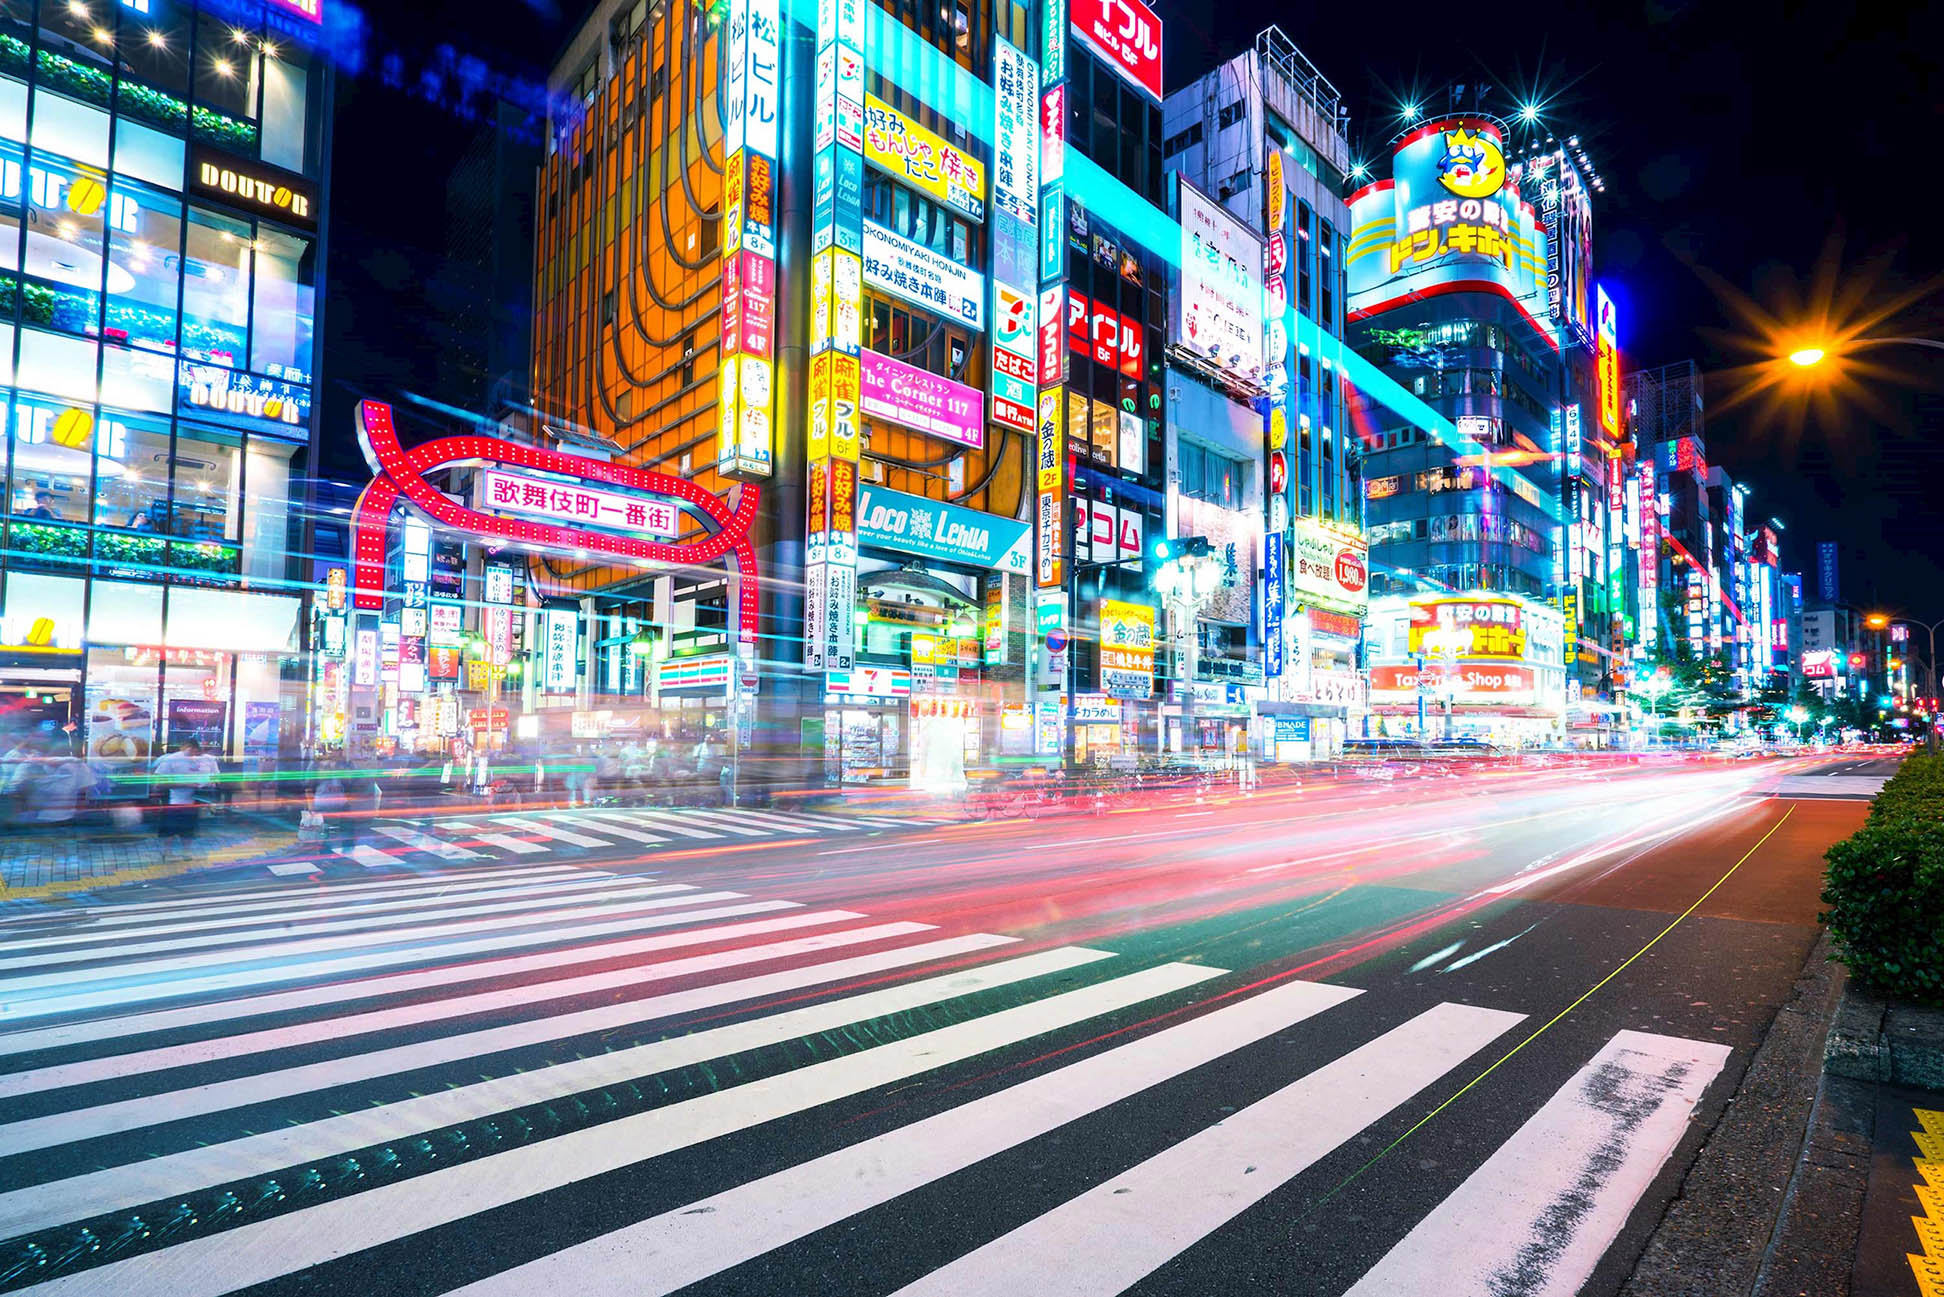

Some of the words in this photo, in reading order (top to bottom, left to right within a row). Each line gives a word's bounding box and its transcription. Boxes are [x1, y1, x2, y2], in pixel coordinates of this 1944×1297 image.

[749, 10, 776, 123] 松ビル
[200, 162, 308, 217] DOUTOR
[863, 224, 930, 262] OKONOMIYAKI
[932, 257, 966, 280] HONJIN
[863, 255, 947, 305] 好み焼き本陣
[1069, 295, 1140, 358] アイフル
[876, 362, 950, 394] ダイニングレストラン
[996, 349, 1034, 380] たばこ
[891, 379, 942, 408] Corner
[948, 398, 968, 416] 117
[1006, 381, 1023, 400] 酒
[965, 427, 979, 442] 4F
[1041, 419, 1055, 471] 金の蔵
[1043, 472, 1057, 486] 2F
[492, 477, 671, 532] 歌舞伎町一番街
[1041, 495, 1052, 581] 東京チカラめし
[1010, 552, 1027, 569] 3F
[1113, 619, 1151, 647] 金の蔵
[1467, 672, 1502, 689] Shop
